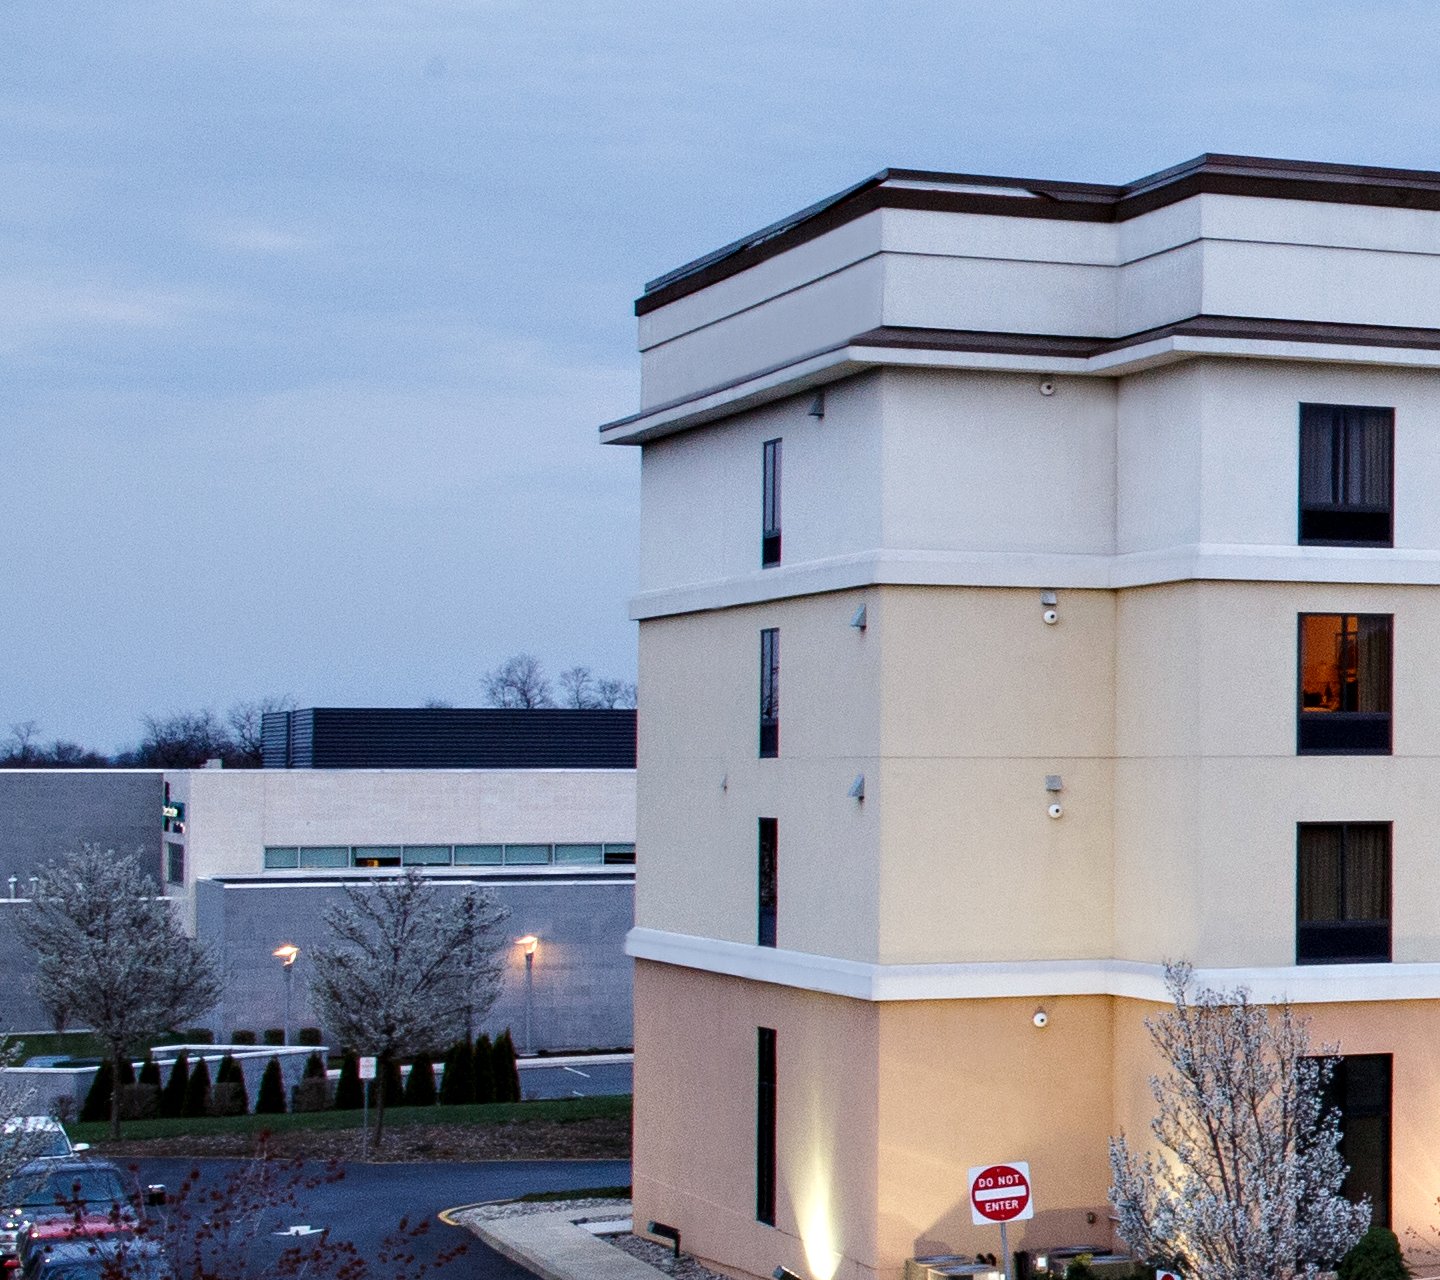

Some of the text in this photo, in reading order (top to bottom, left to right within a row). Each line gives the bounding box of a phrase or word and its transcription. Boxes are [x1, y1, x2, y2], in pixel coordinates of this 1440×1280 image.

[978, 1174, 1020, 1188] DO NOT
[985, 1200, 1019, 1213] ENTER
